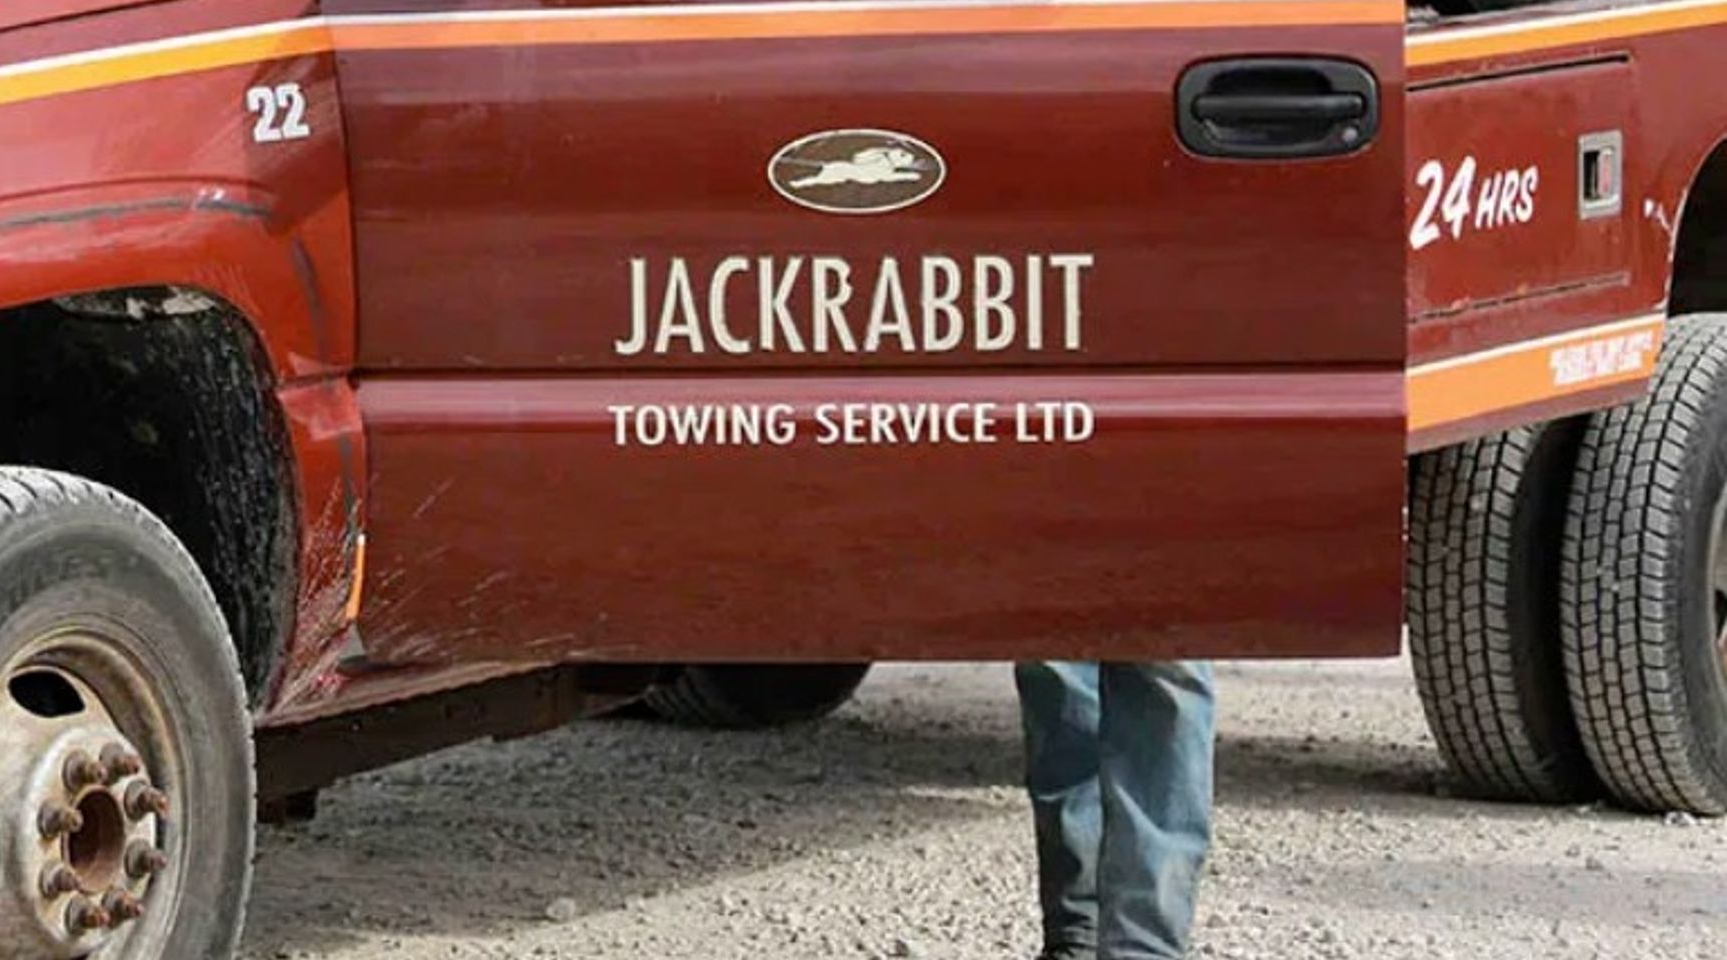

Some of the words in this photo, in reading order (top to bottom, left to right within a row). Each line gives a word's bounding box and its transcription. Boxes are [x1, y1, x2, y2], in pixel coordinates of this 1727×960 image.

[246, 82, 311, 144] 22
[1409, 155, 1477, 250] 24
[1476, 166, 1538, 228] HRS
[614, 254, 1094, 356] JACKRABBIT
[608, 403, 797, 446] TOWING
[815, 401, 997, 444] SERVICE
[1015, 400, 1095, 443] LTD
